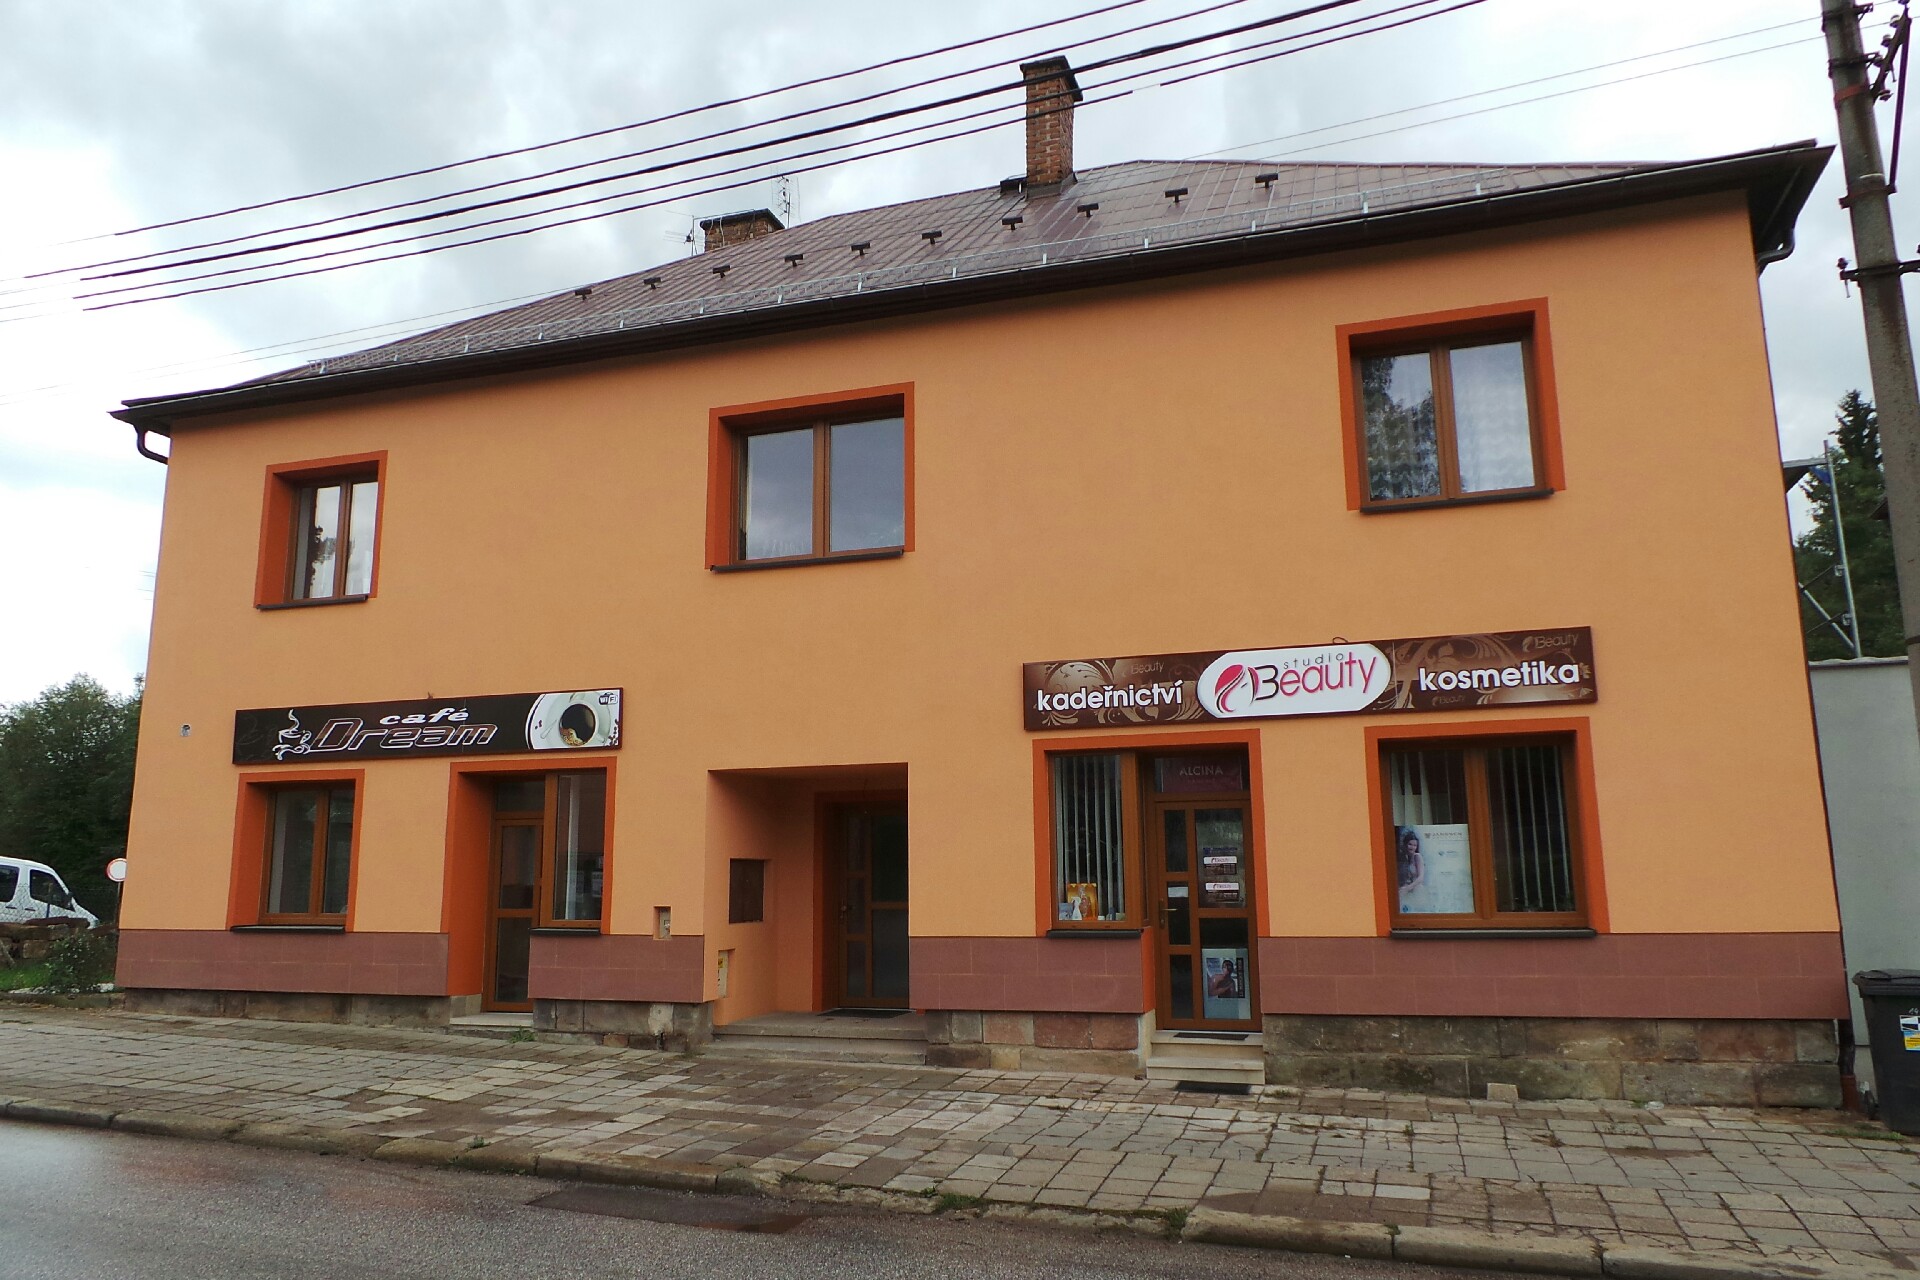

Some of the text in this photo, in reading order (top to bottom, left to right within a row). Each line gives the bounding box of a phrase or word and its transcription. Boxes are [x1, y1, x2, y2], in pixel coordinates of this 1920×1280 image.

[1249, 651, 1377, 703] Beauty
[1283, 652, 1344, 670] studio
[1418, 660, 1580, 692] kosmetika
[1036, 679, 1184, 712] kadeřnictví
[379, 707, 470, 725] café
[308, 717, 499, 753] Dream
[1179, 764, 1224, 776] ALCINA
